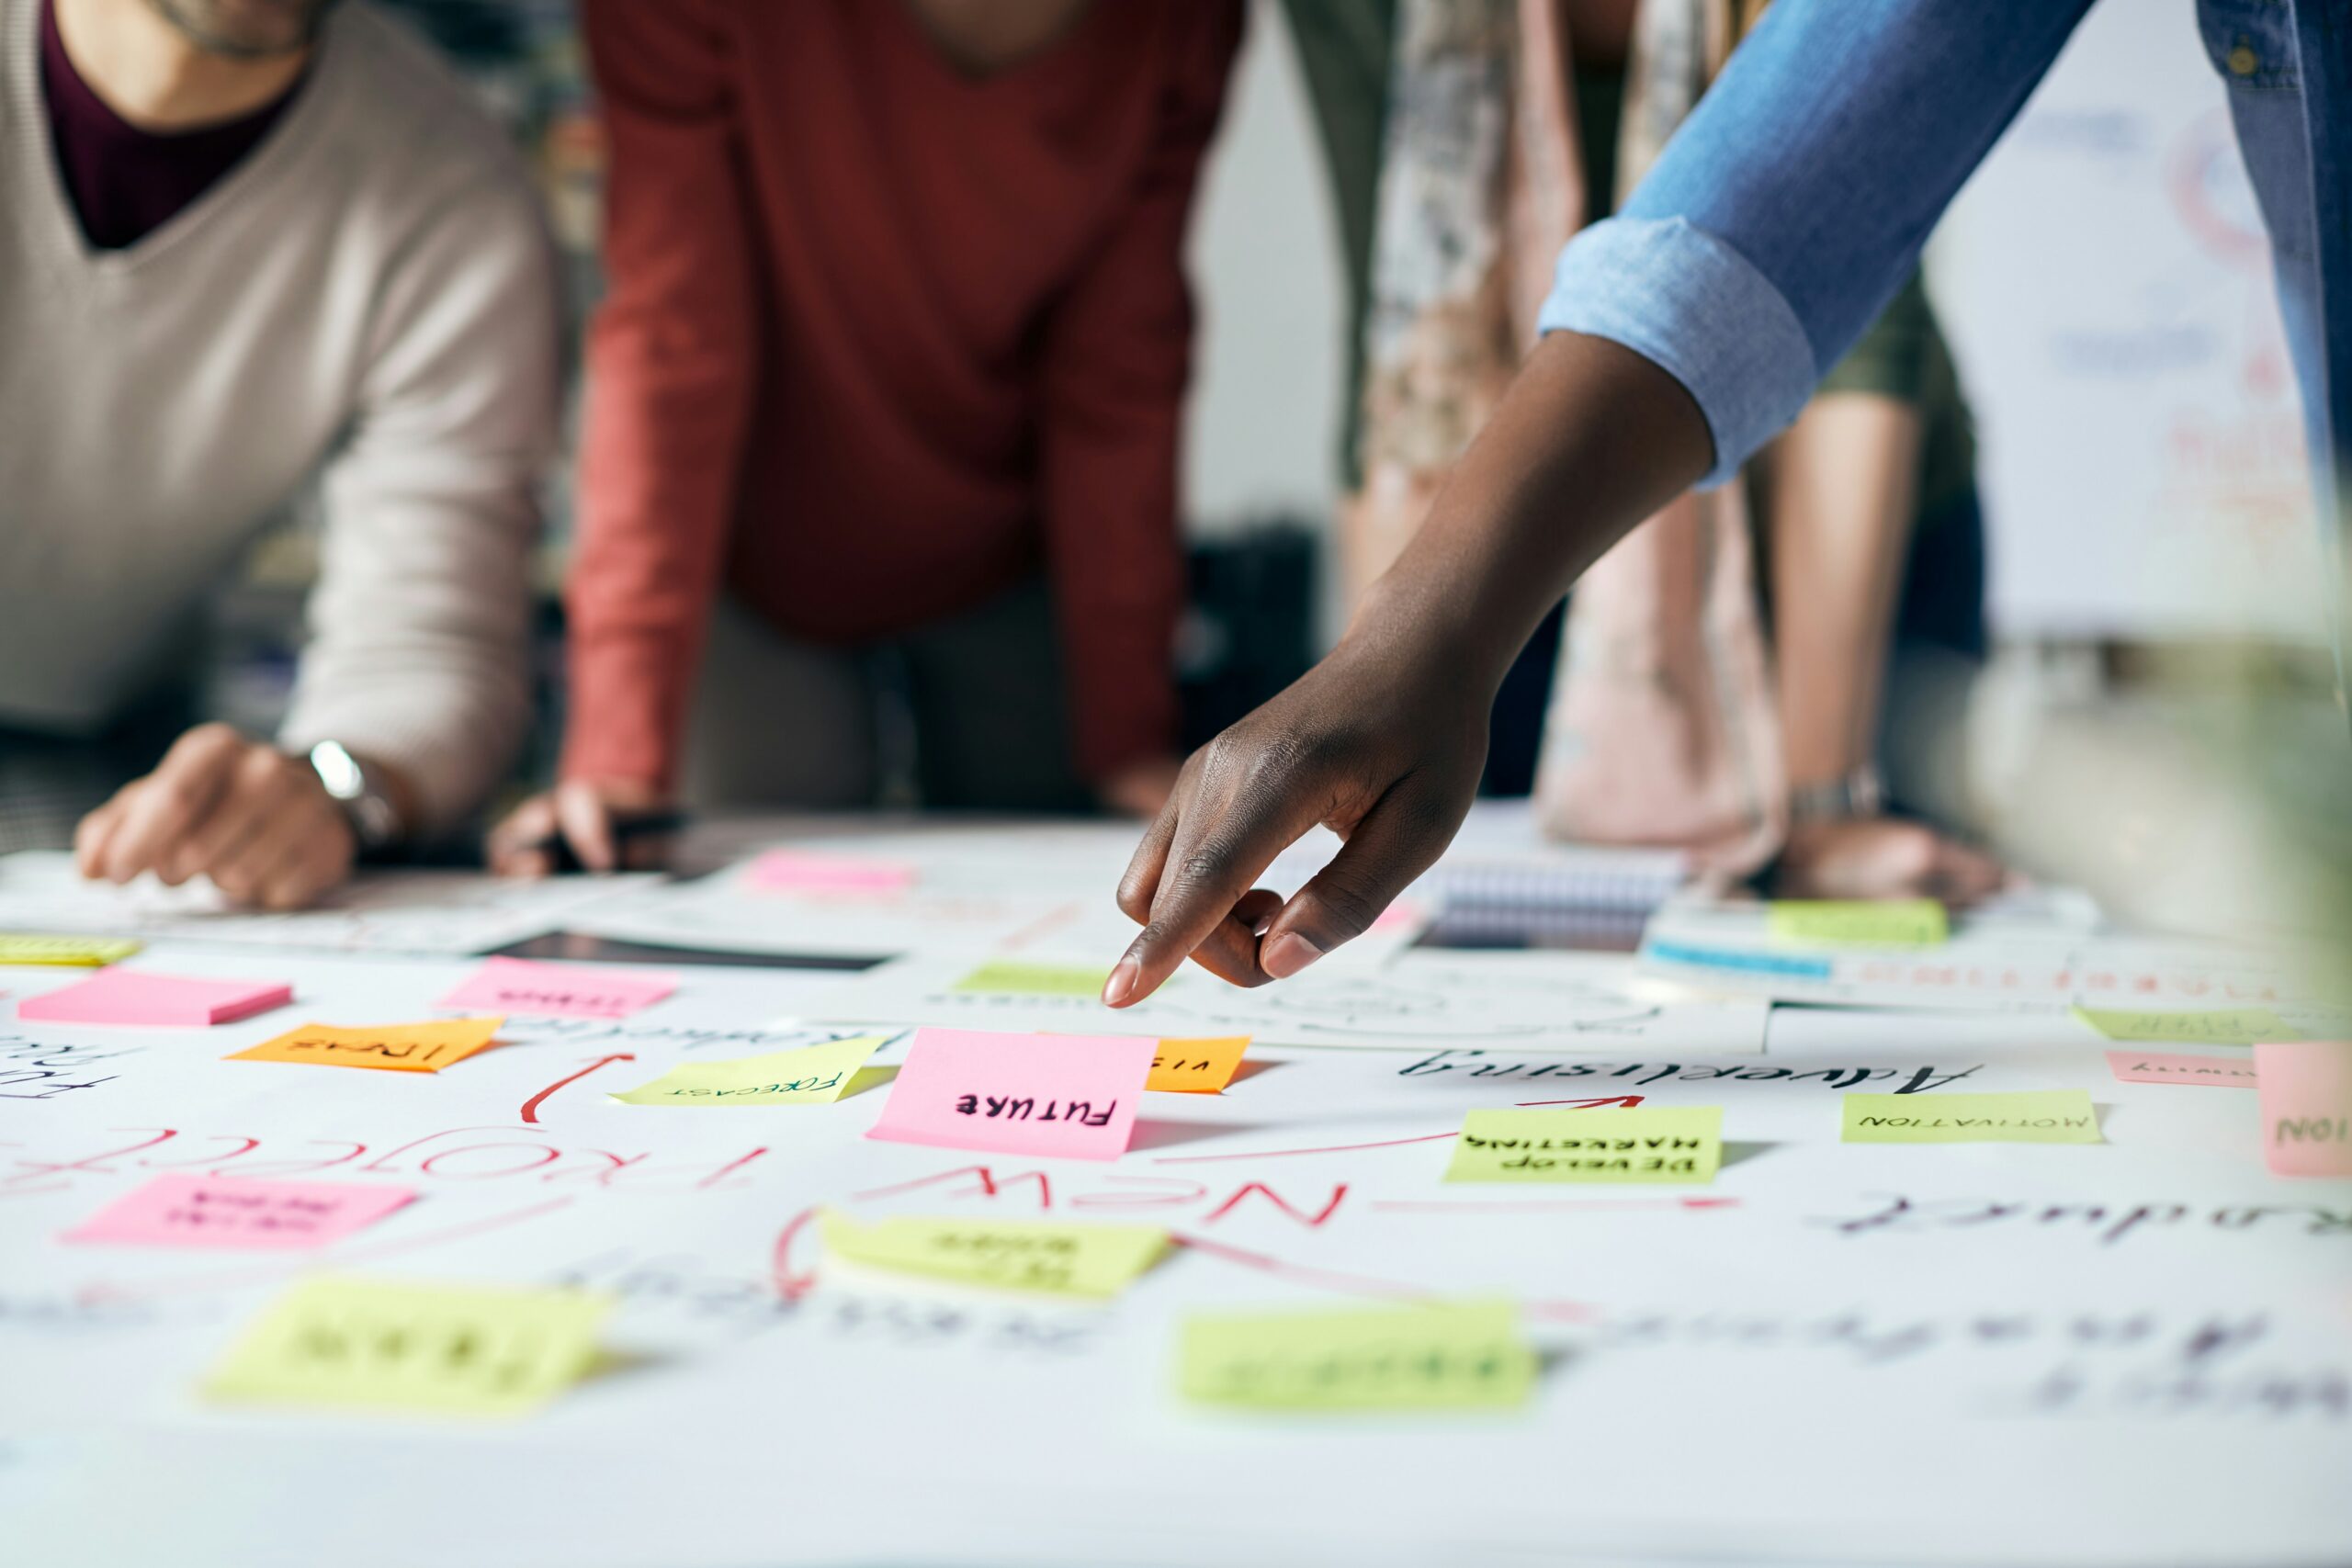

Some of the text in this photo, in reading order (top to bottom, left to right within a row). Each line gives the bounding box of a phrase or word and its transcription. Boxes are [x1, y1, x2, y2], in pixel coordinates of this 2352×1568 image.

[662, 1069, 843, 1100] FORECAST
[954, 1093, 1117, 1128] FUTURE
[1857, 1113, 2090, 1131] MOTIVATION
[1464, 1134, 1701, 1154] MARKETING
[1499, 1154, 1699, 1175] DEVELOP
